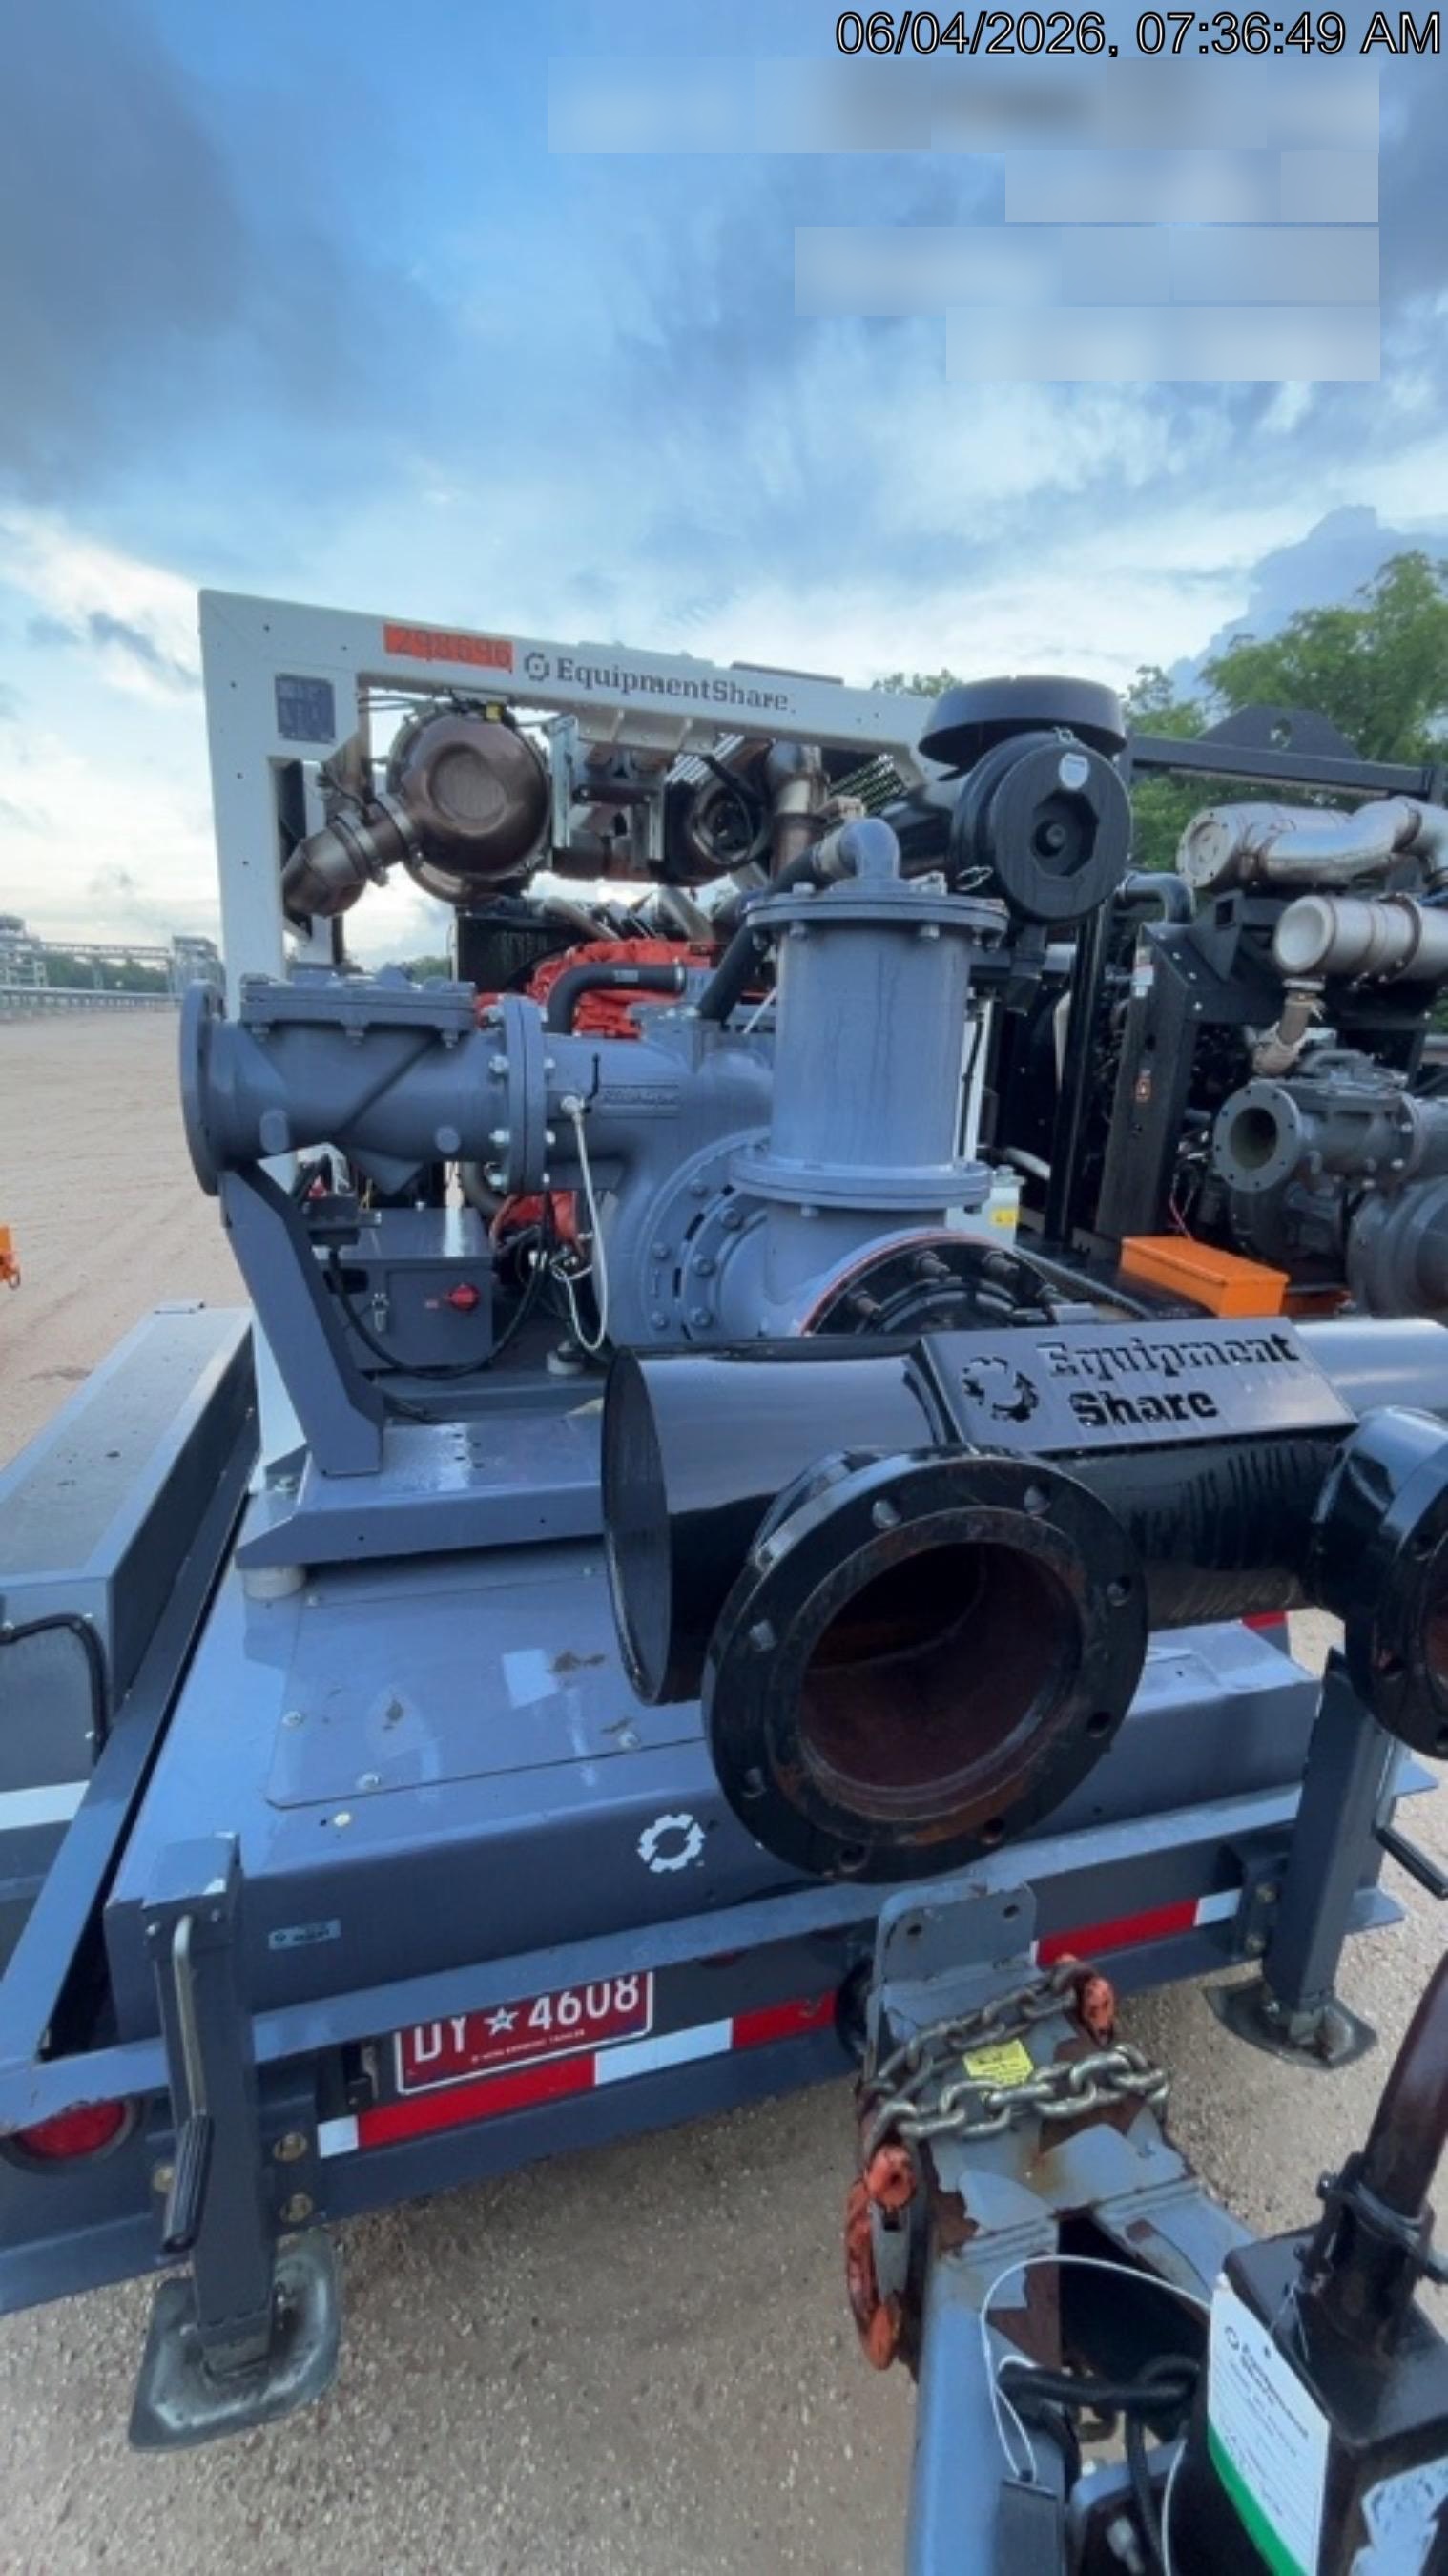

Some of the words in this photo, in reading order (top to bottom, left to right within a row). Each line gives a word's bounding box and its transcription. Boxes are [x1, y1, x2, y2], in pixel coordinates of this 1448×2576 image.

[1036, 1333, 1299, 1381] Equipment
[1069, 1390, 1219, 1426] Share
[528, 1975, 639, 2030] 4608
